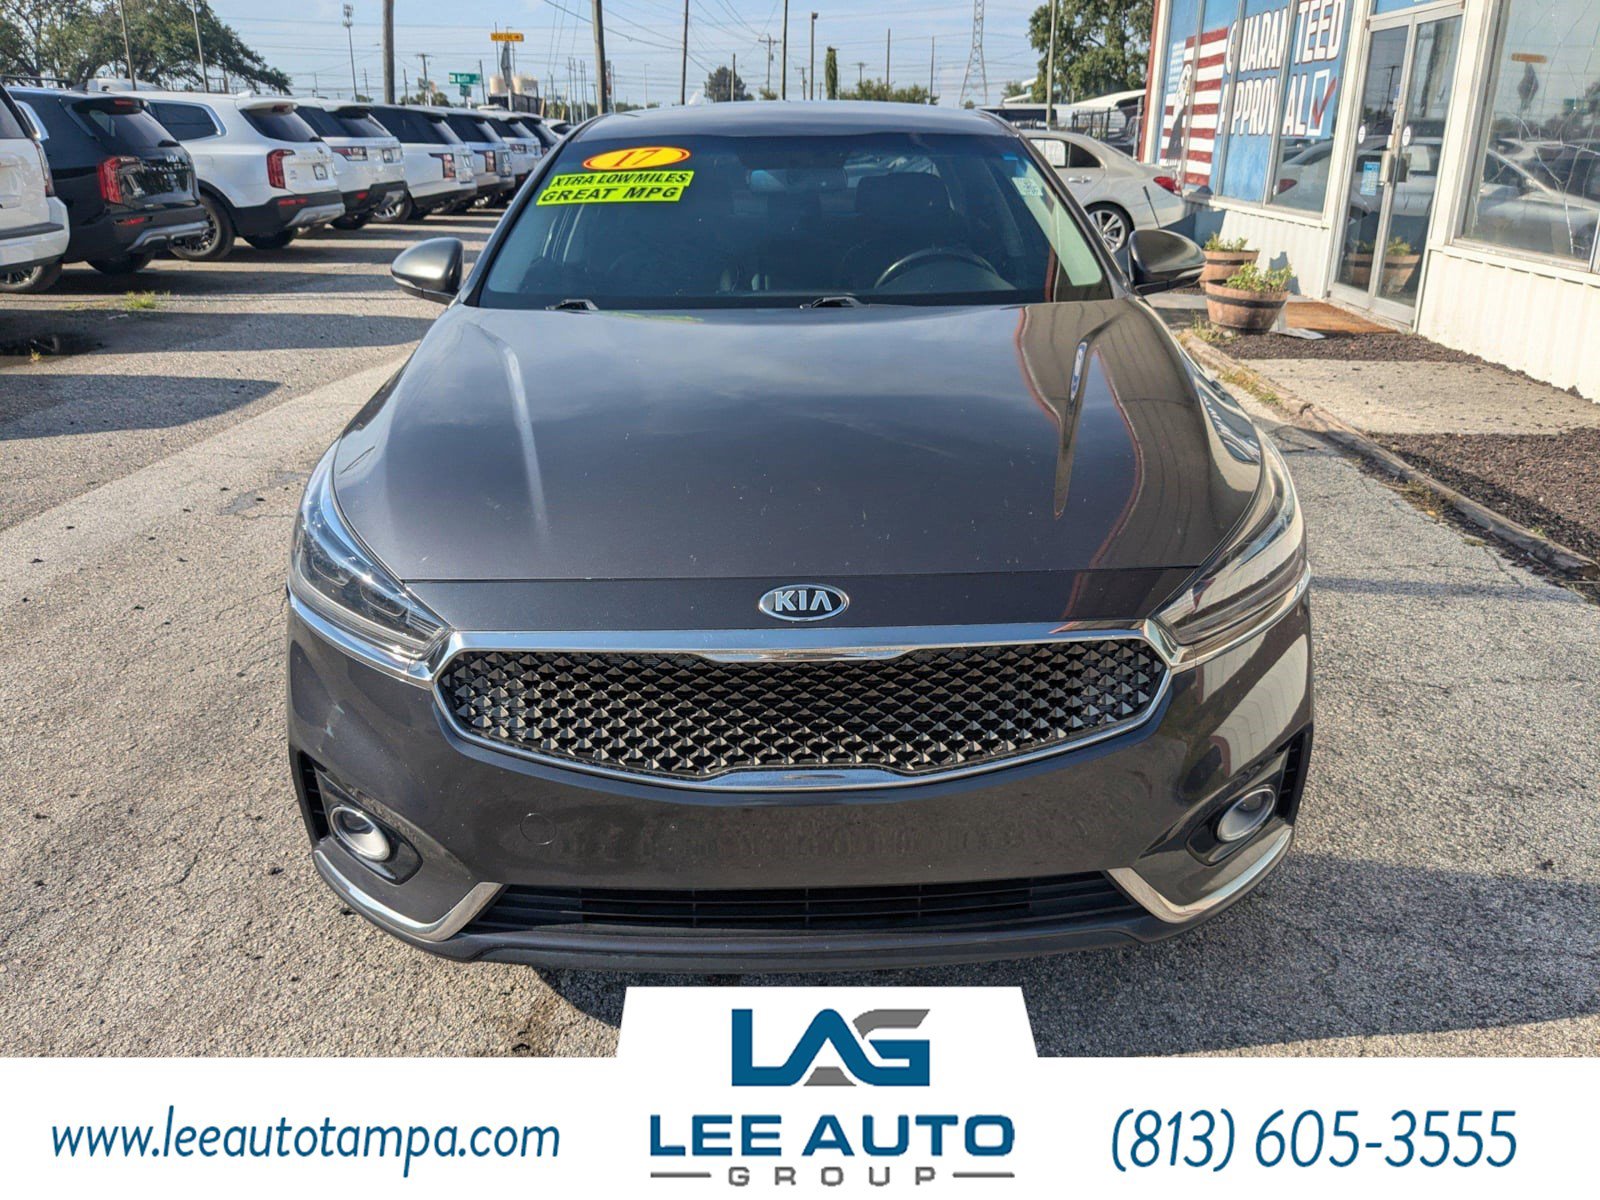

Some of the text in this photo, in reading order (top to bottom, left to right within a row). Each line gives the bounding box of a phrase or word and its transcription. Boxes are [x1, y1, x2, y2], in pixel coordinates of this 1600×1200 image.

[611, 149, 662, 168] 17
[551, 172, 689, 188] XTRA LOW MILES
[541, 186, 679, 202] GREAT MPG
[774, 590, 833, 612] KIA
